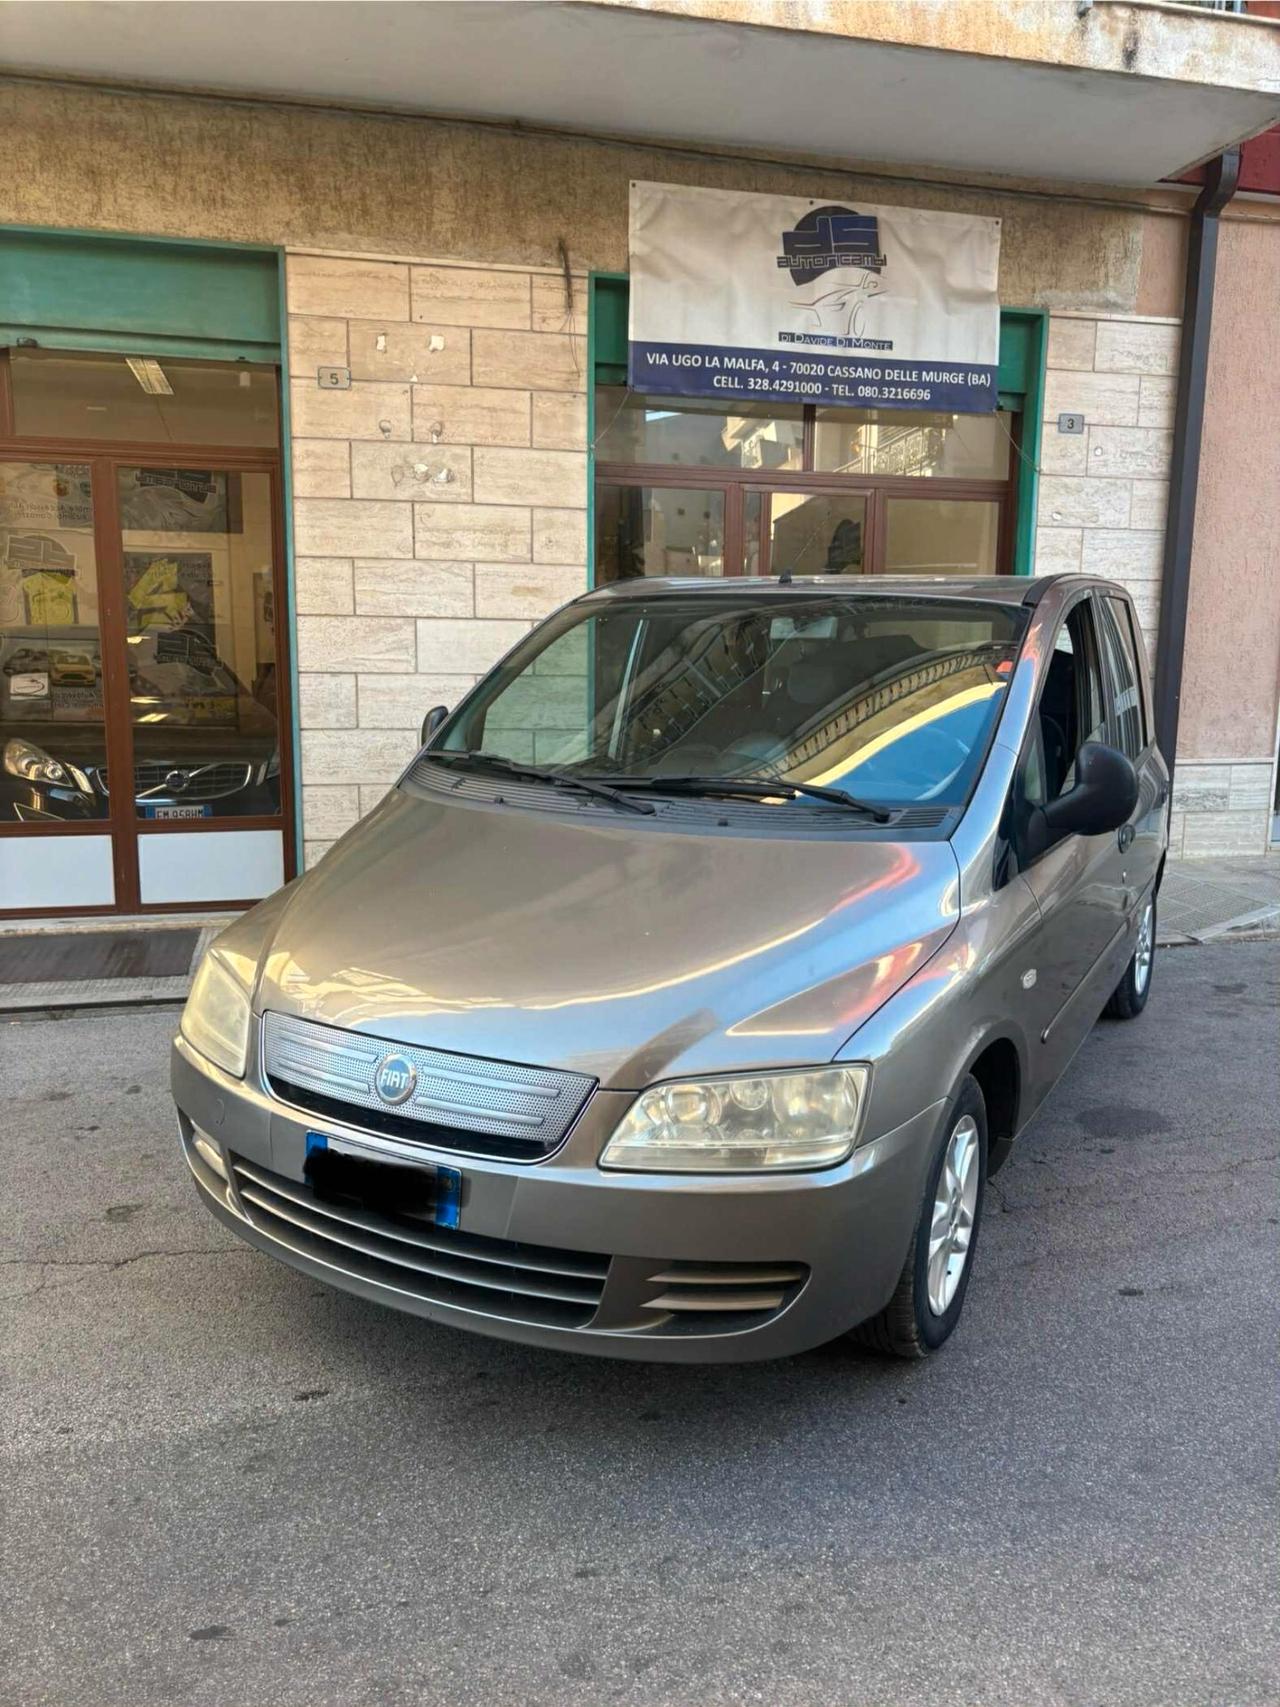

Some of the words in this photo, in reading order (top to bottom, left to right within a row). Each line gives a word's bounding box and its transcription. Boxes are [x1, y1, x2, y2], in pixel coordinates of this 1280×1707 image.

[330, 372, 339, 385] 5
[646, 352, 668, 366] VIA
[672, 354, 702, 367] UGO
[705, 356, 720, 369] LA
[723, 357, 769, 373] MALFA,
[771, 361, 780, 372] 4
[790, 362, 825, 376] 70020
[827, 365, 882, 381] CASSANO
[885, 369, 919, 382] DELLE
[921, 371, 965, 385] MURGE
[967, 372, 991, 388] (BA)
[713, 376, 744, 389] CELL.
[747, 378, 822, 395] 328.4291000
[832, 384, 855, 397] TEL.
[857, 385, 931, 401] 080.3216696
[1067, 418, 1075, 430] 3
[380, 1068, 409, 1089] FIAT
